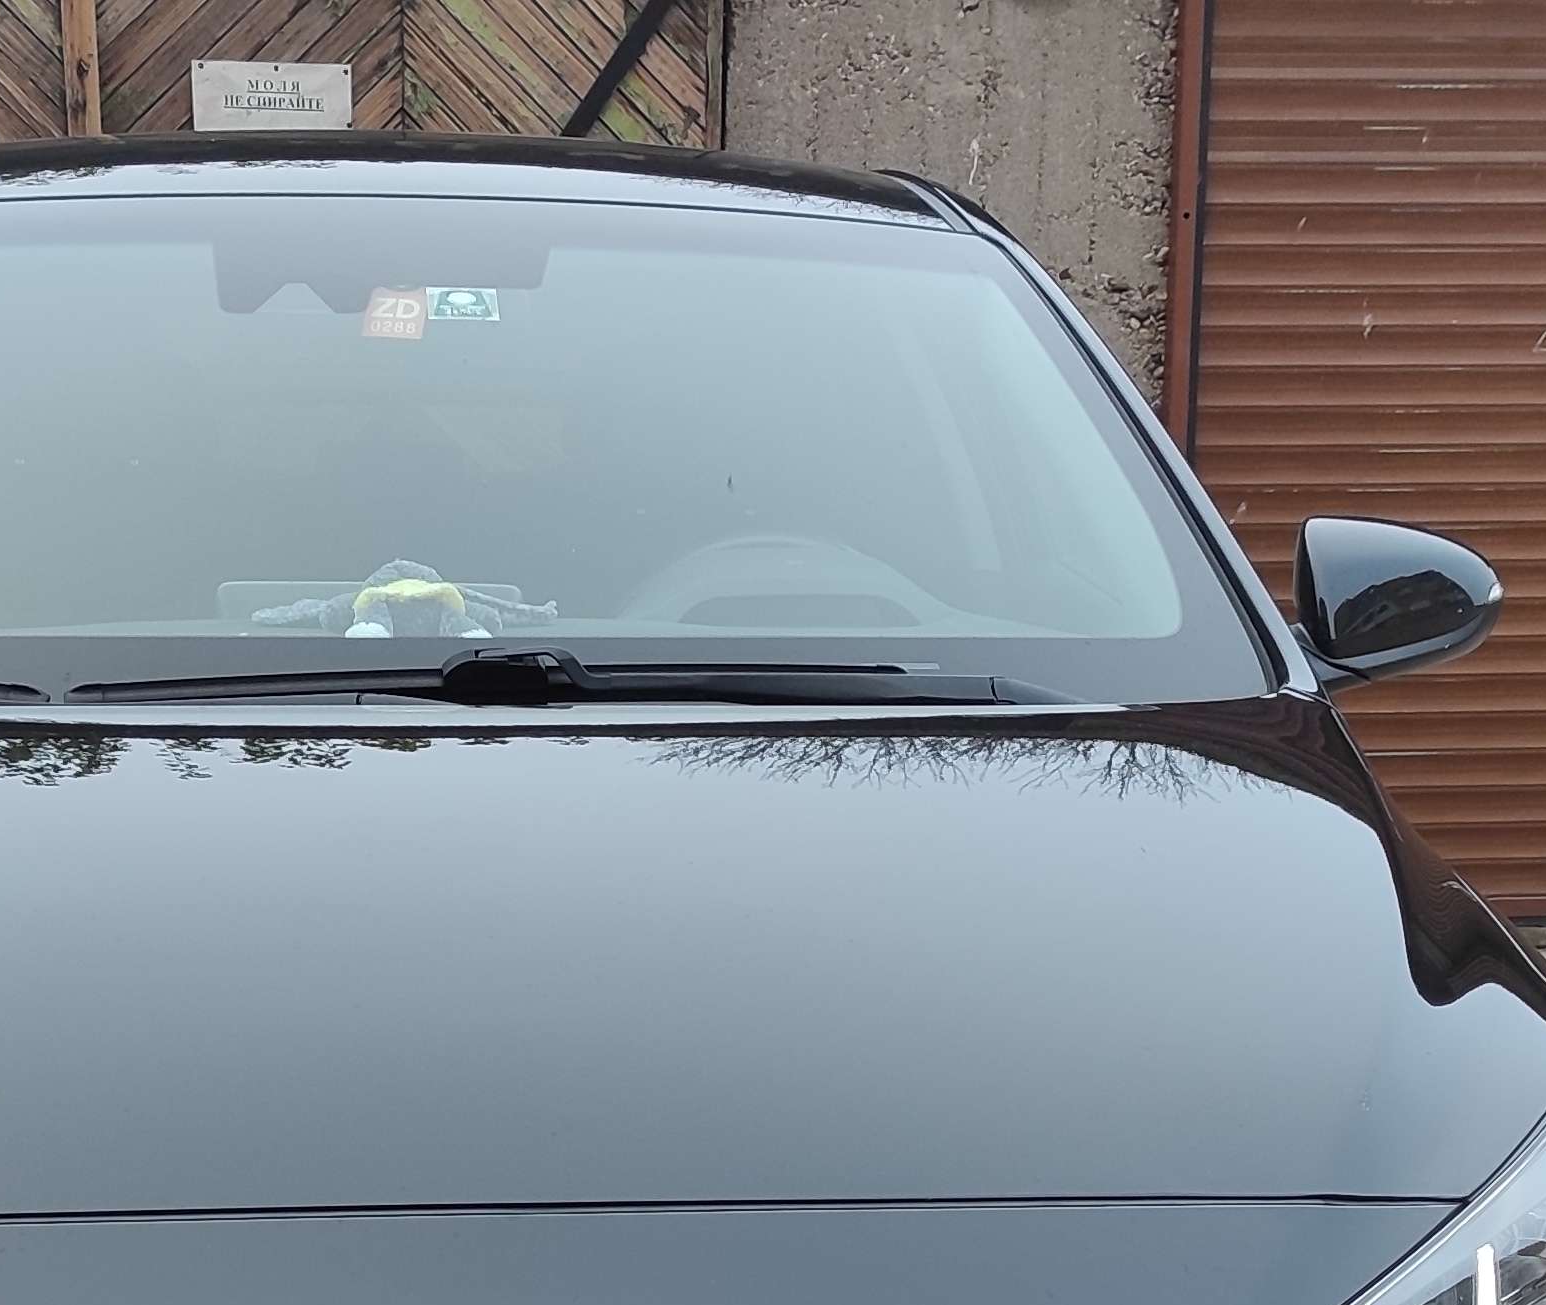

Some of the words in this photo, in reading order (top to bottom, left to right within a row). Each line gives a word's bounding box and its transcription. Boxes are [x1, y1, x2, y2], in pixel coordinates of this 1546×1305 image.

[247, 79, 301, 92] МОЛЯ
[224, 94, 243, 106] НЕ
[246, 95, 324, 110] СПИРАЙТЕ
[371, 297, 421, 319] ZD
